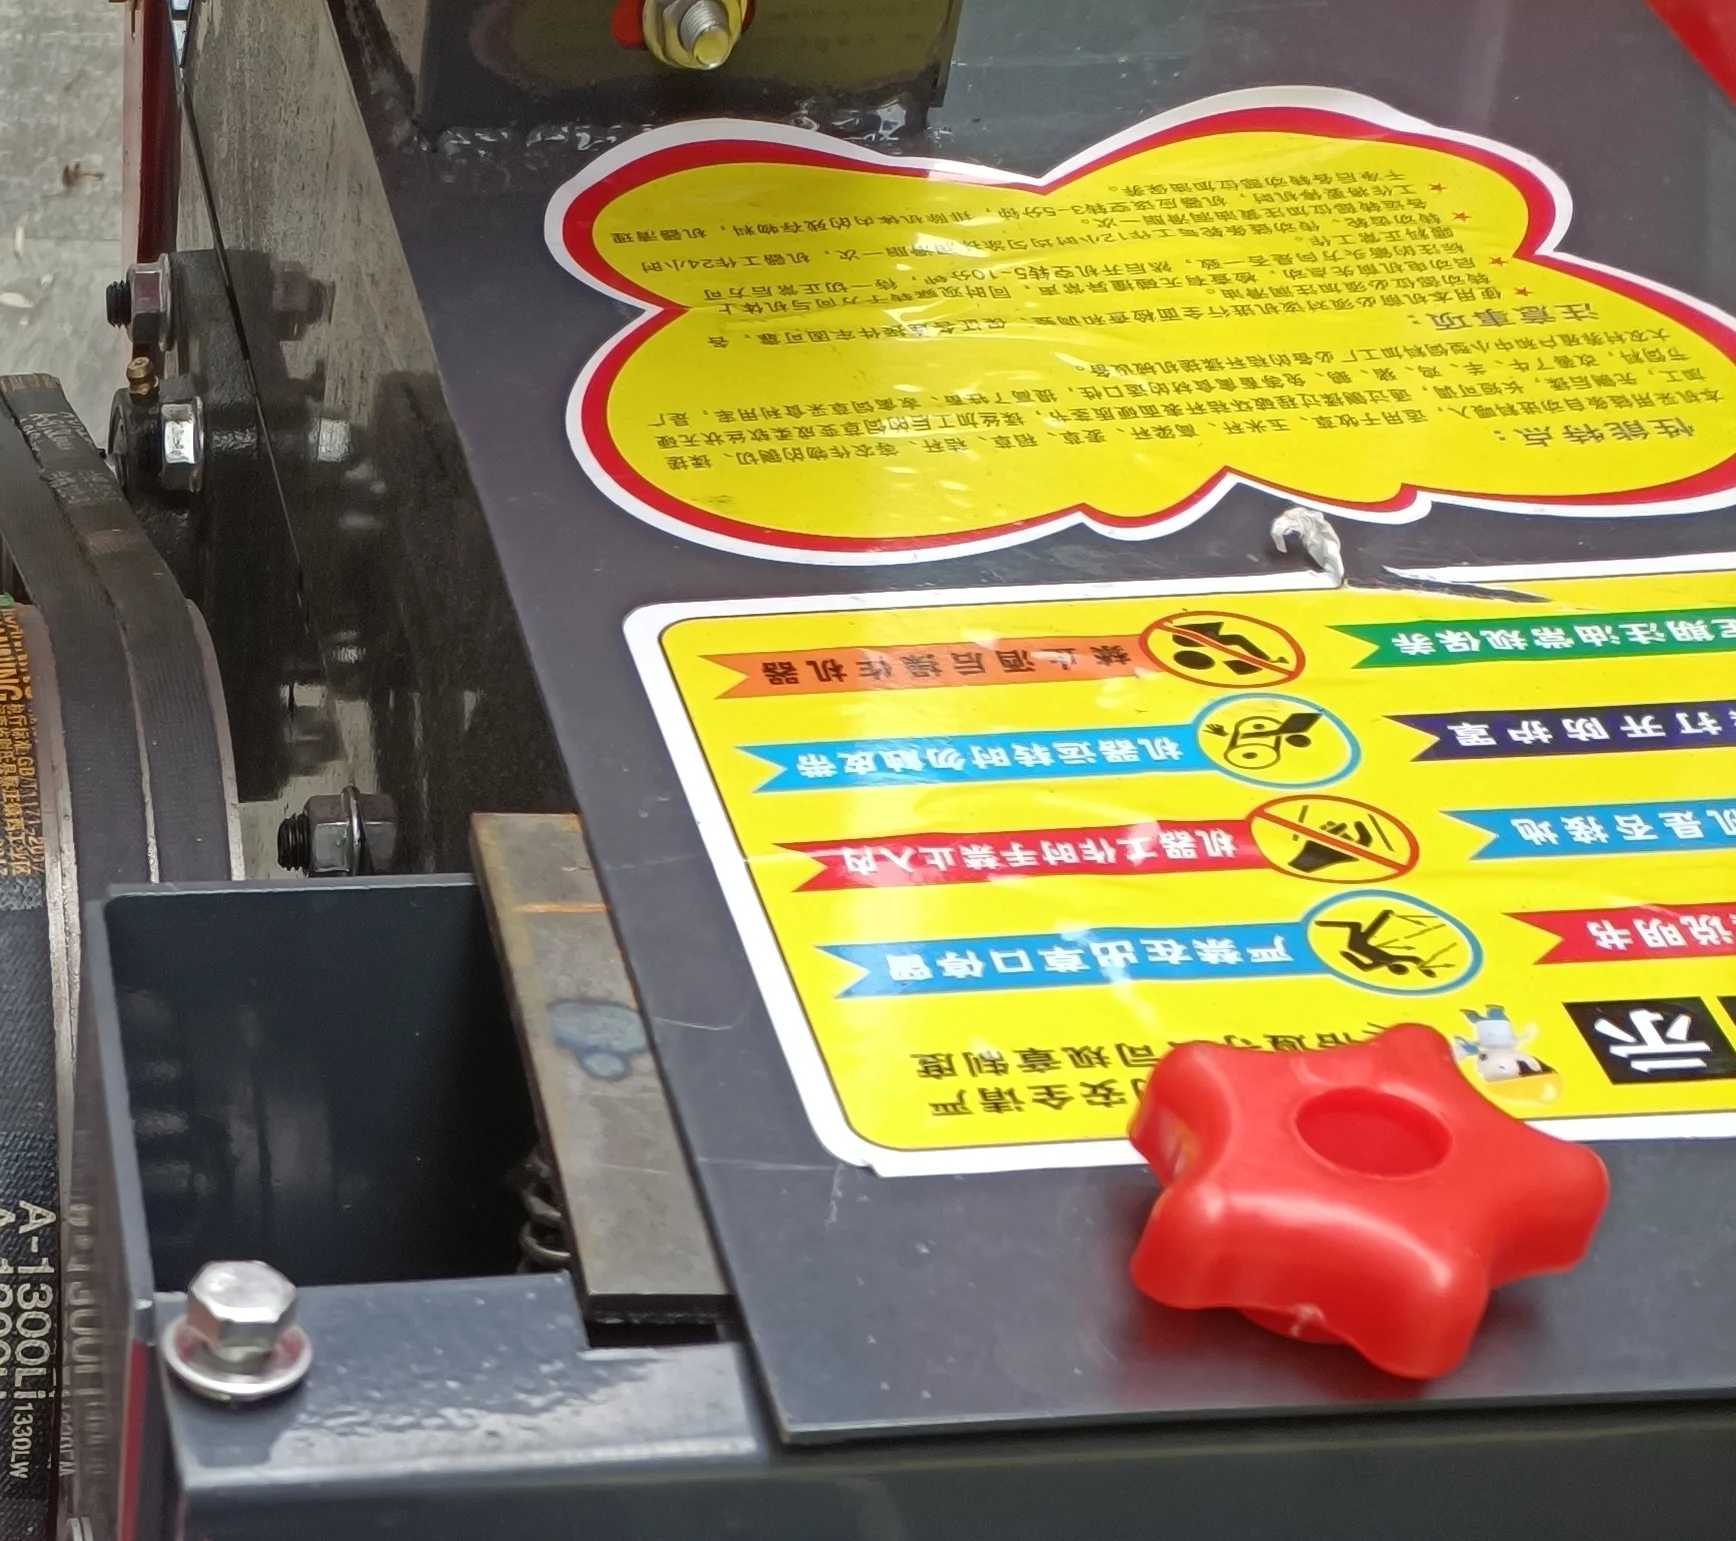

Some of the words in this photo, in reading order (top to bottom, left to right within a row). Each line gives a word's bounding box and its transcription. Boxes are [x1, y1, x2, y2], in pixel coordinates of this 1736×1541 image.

[759, 643, 1127, 685] 禁止酒后操作机器
[1443, 709, 1736, 747] 打开防护罩
[794, 733, 1184, 778] 机器运转时勿触皮带
[839, 826, 1235, 877] 机器工作时手禁止入内
[1583, 912, 1736, 952] 说明书
[884, 933, 1293, 980] 严禁在出草口停留
[1592, 1006, 1711, 1073] 示
[927, 1077, 1148, 1116] 安全请严
